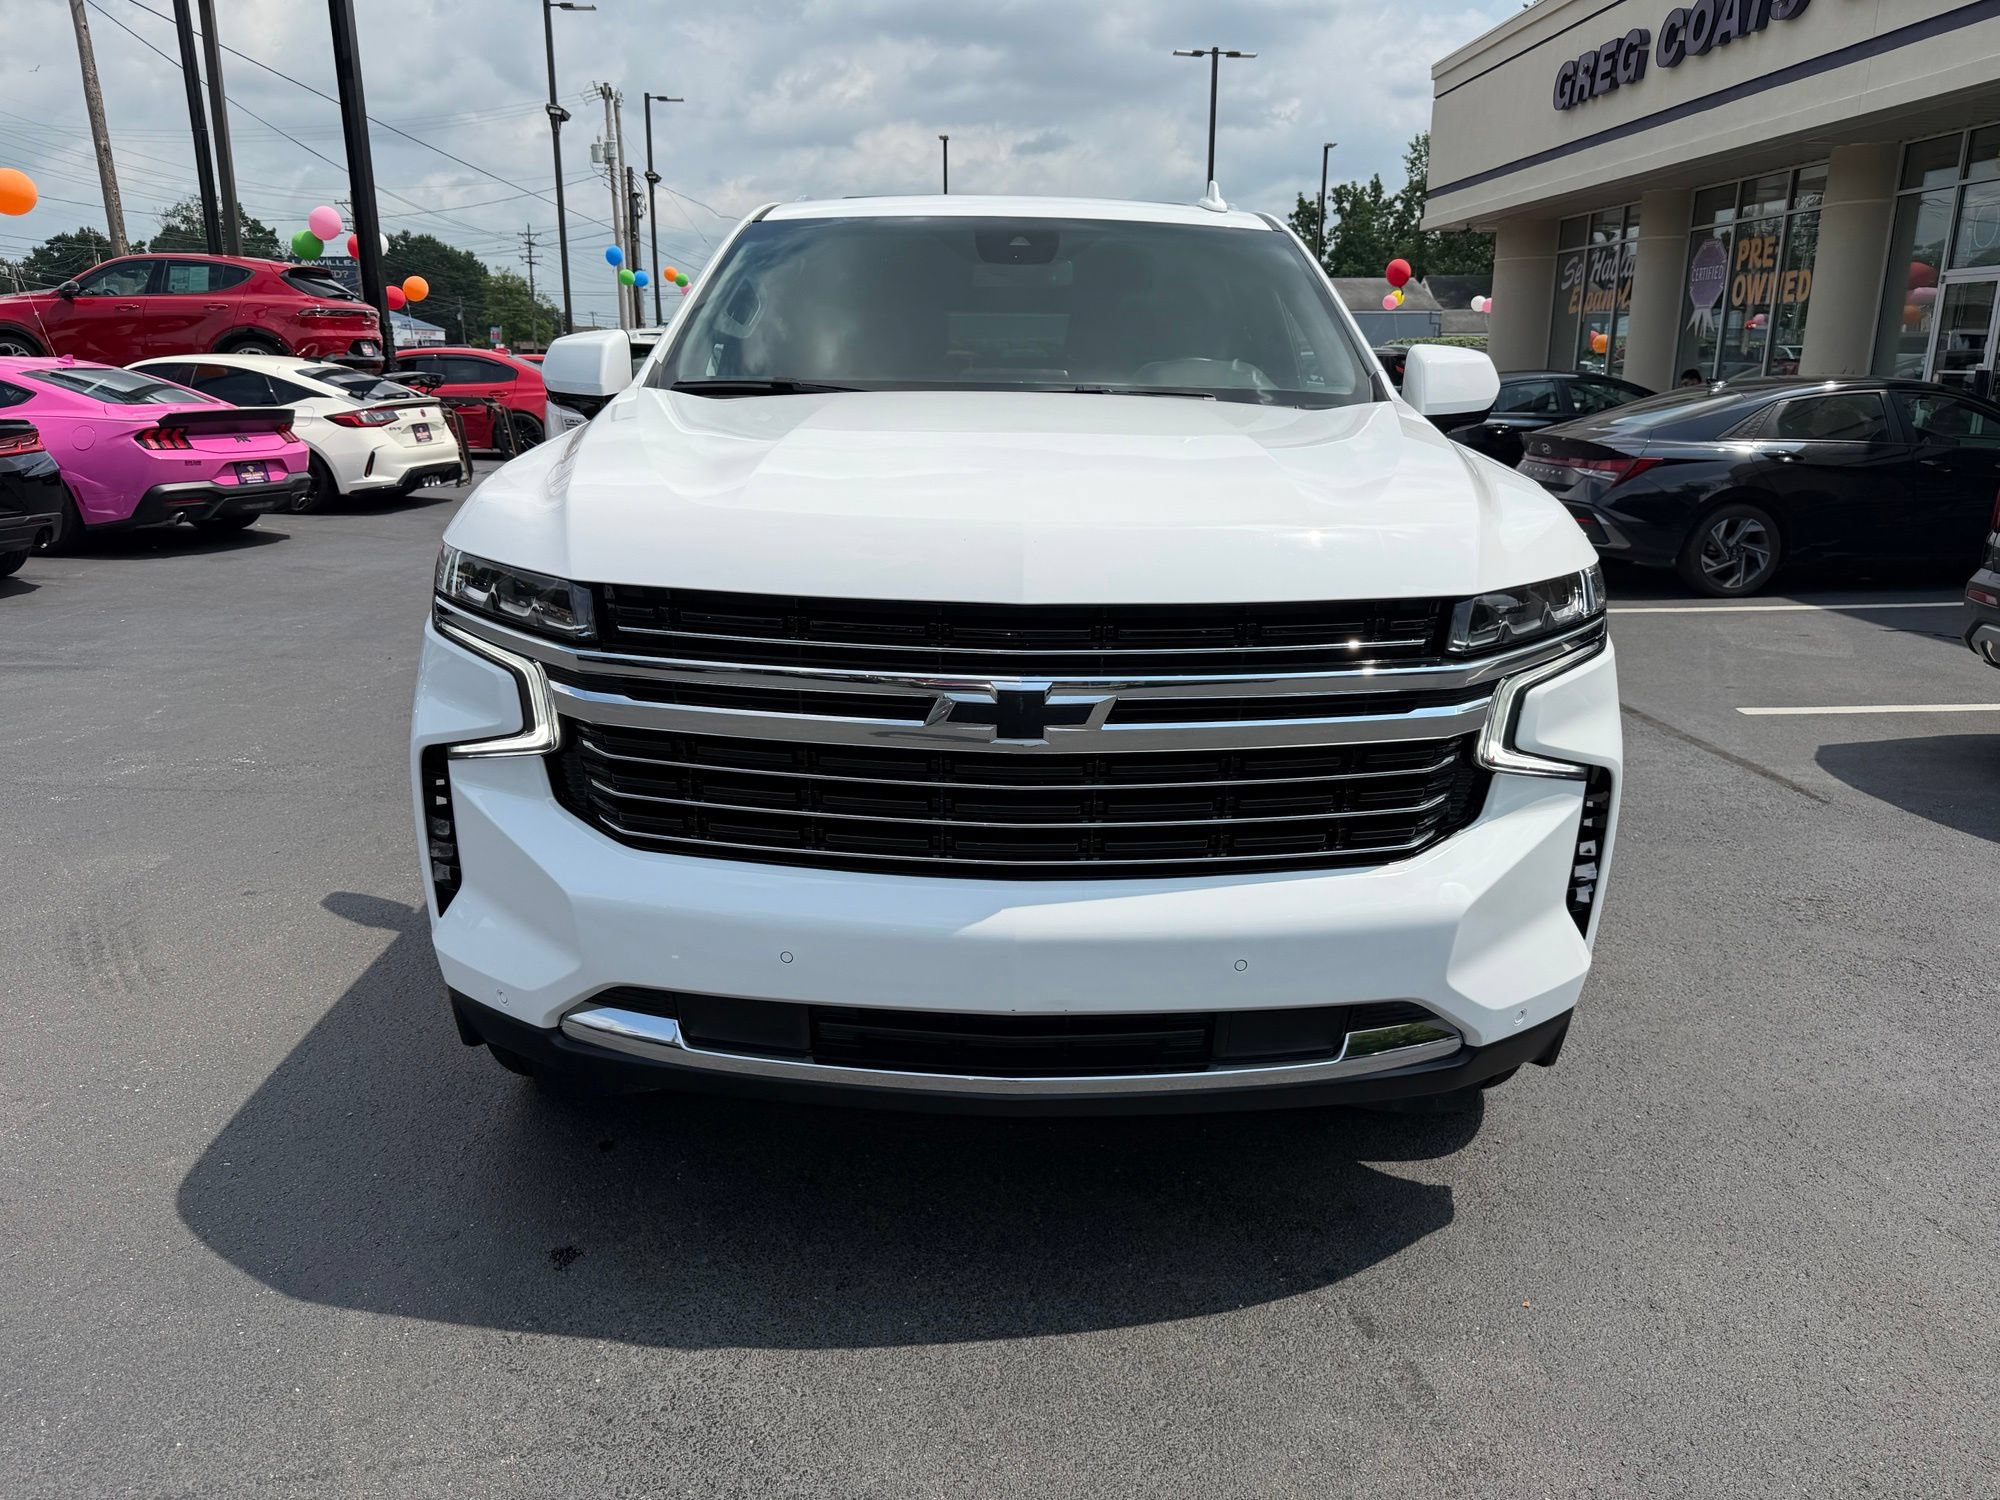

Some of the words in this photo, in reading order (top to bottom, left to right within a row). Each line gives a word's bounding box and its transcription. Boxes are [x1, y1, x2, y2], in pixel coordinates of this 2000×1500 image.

[1553, 28, 1650, 110] GREG
[1691, 264, 1724, 282] CERTIFIED
[1731, 269, 1812, 306] OWNED
